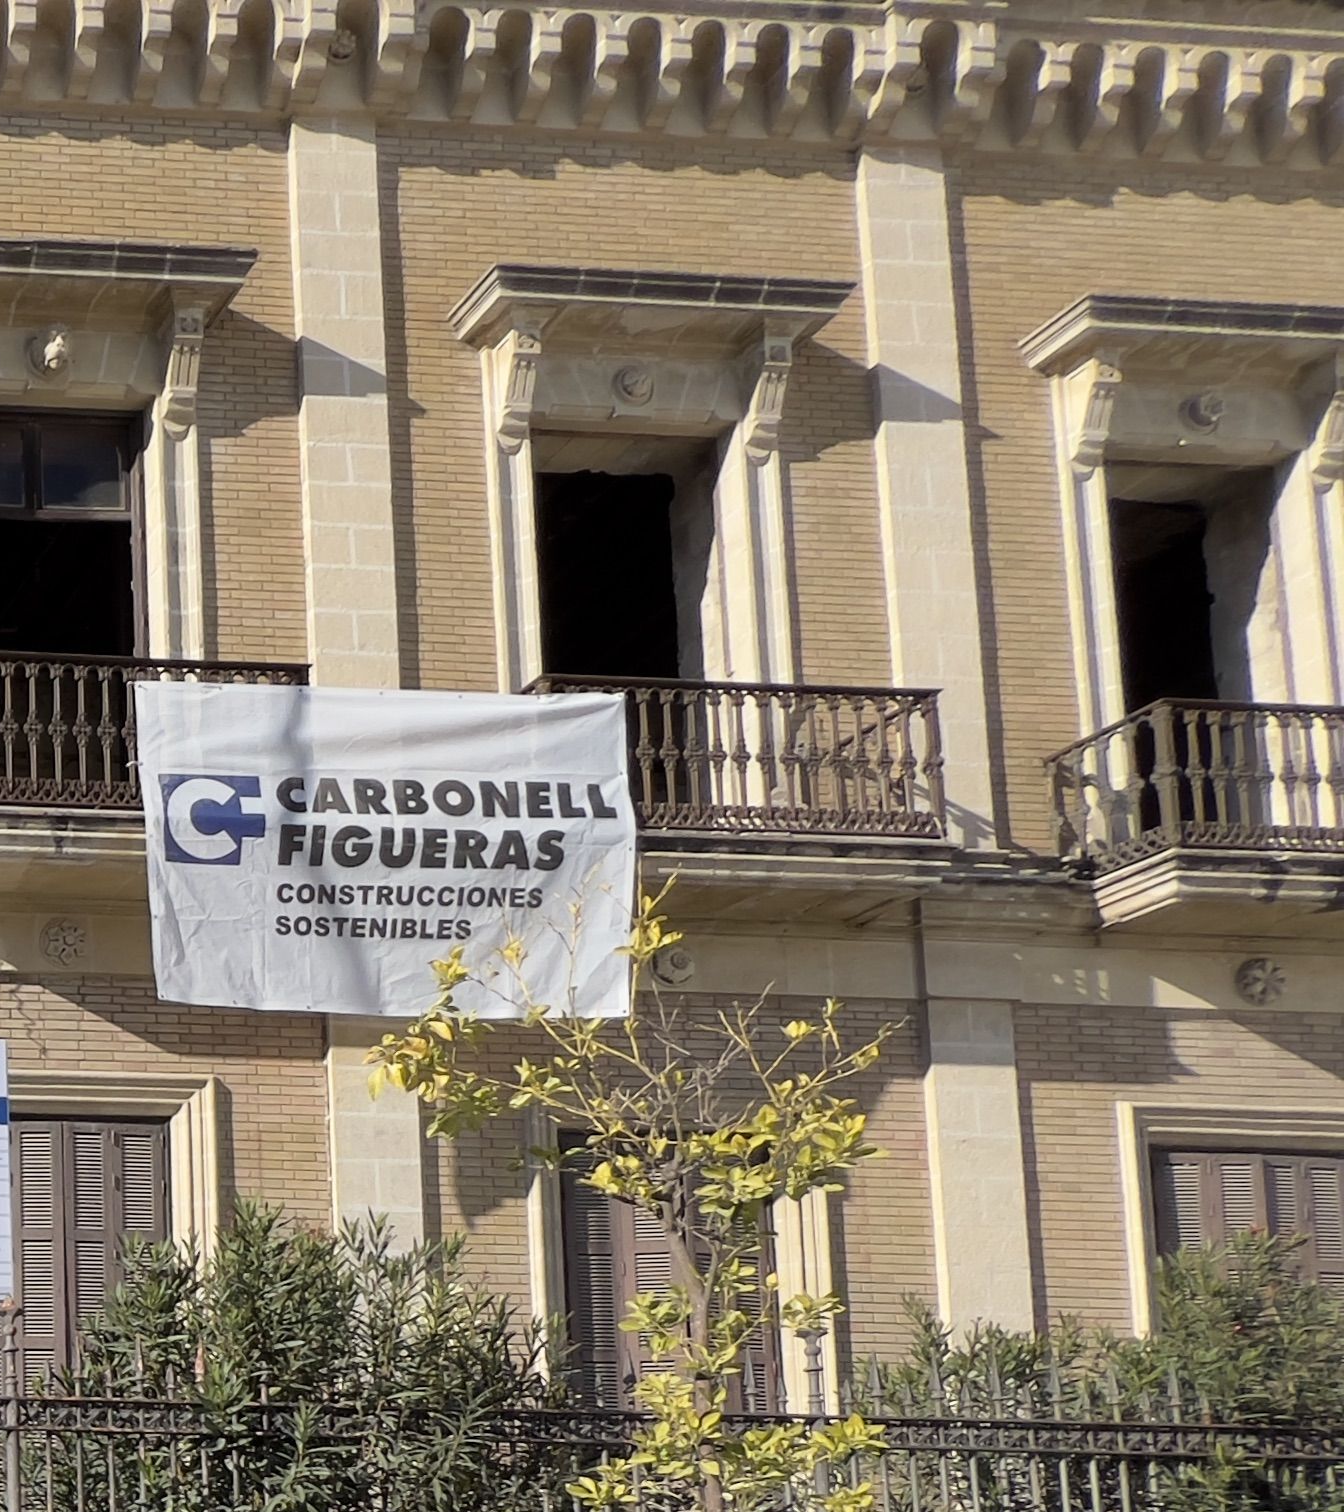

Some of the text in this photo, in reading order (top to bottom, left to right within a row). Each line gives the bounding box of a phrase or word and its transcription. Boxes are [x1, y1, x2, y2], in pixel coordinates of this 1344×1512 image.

[276, 777, 618, 819] CARBONELL
[277, 824, 566, 872] FIGUERAS
[276, 883, 543, 909] CONSTRUCCIONES
[275, 915, 472, 940] SOSTENIBLES
